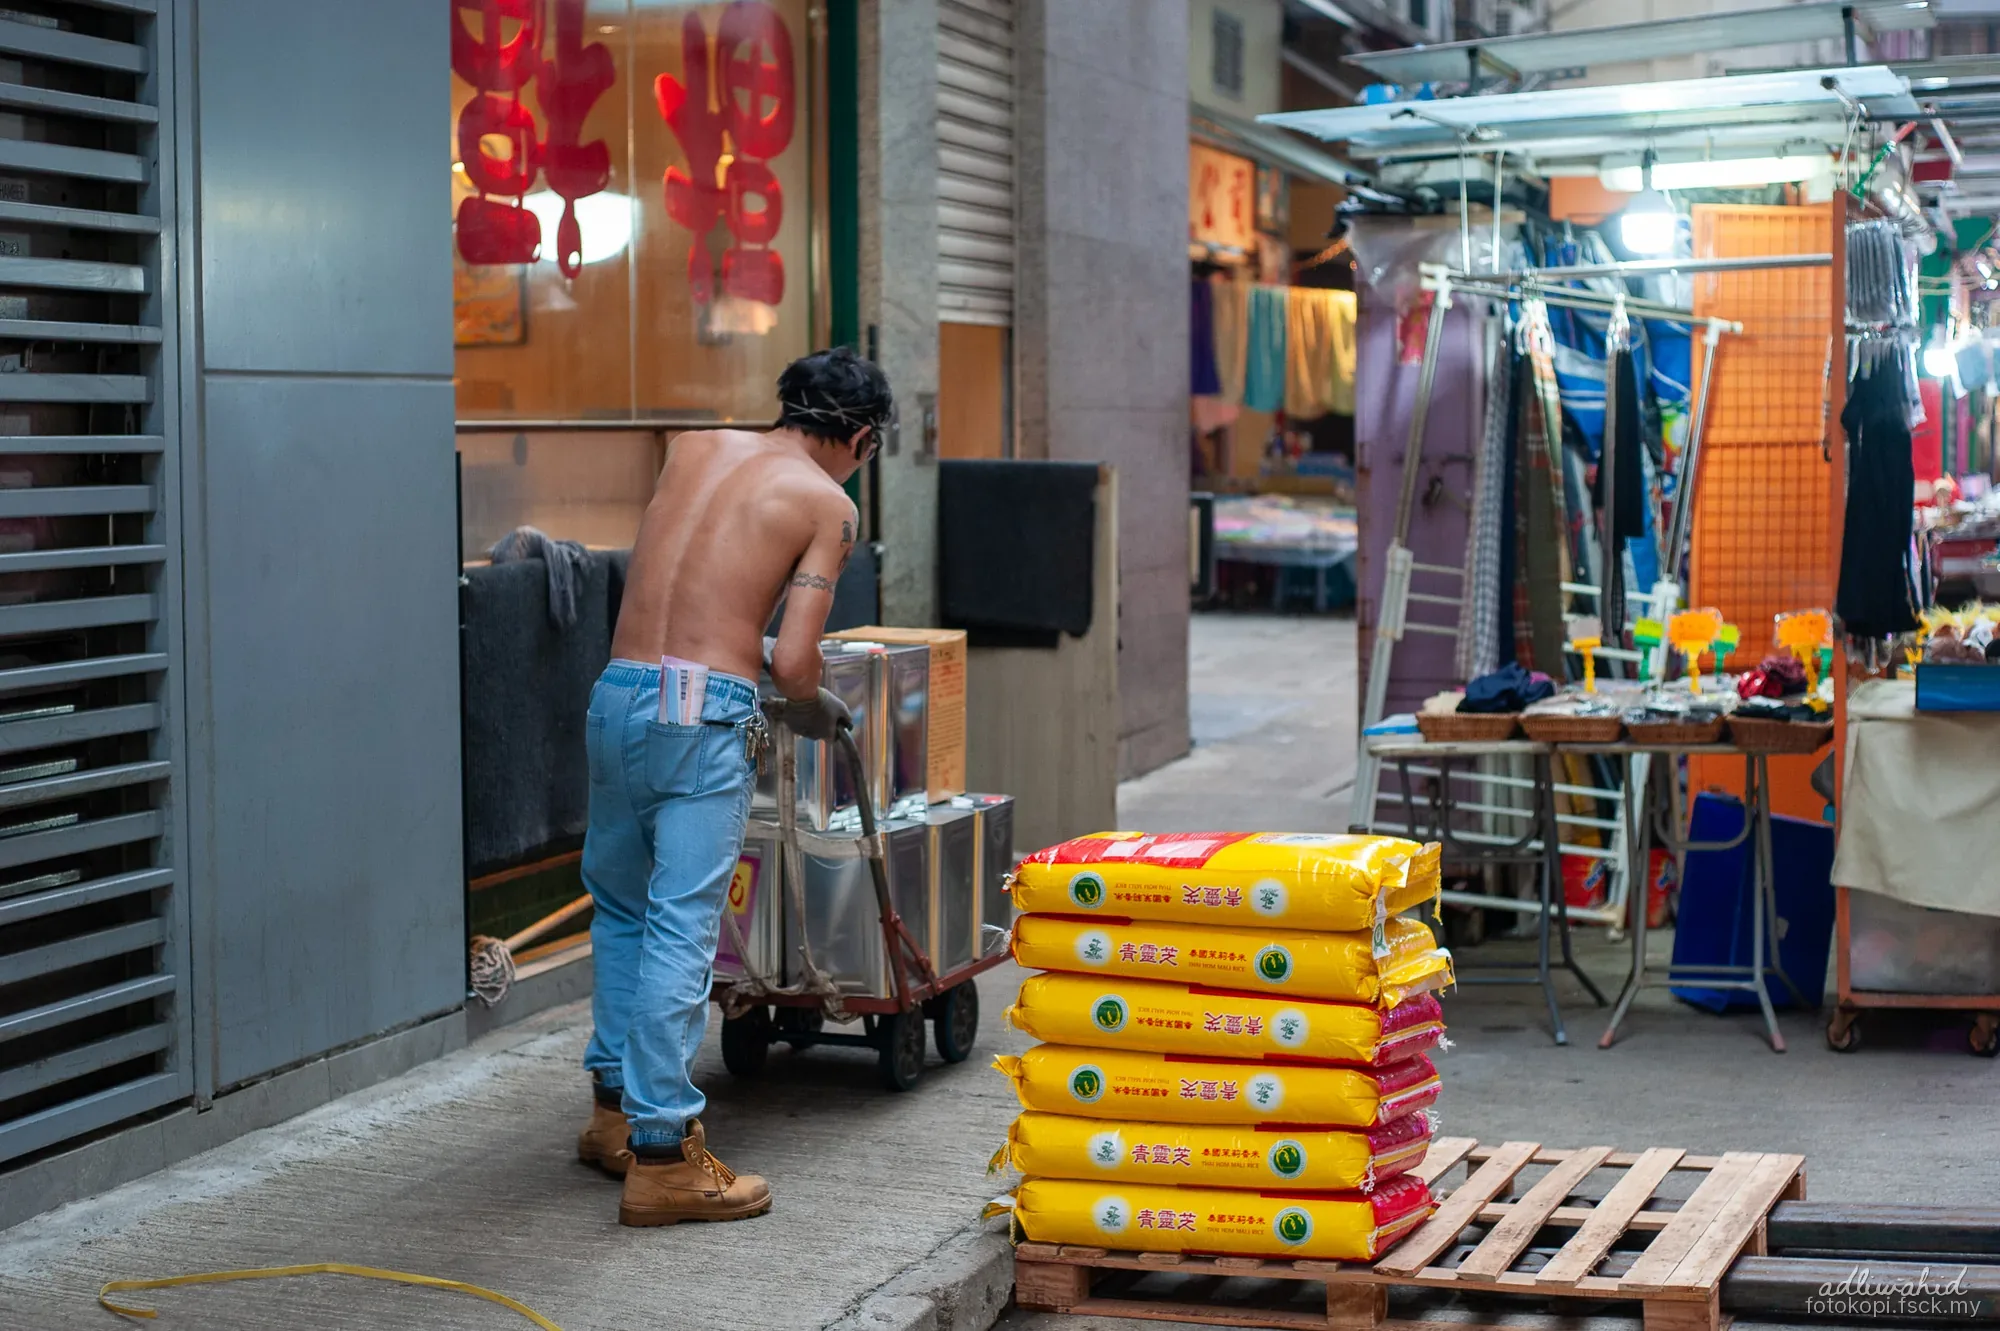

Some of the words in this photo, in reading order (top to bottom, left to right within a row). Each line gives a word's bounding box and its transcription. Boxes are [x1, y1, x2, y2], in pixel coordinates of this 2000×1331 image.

[1181, 885, 1243, 907] 青靈芝
[1119, 943, 1179, 967] 青靈芝
[1203, 1012, 1264, 1036] 青靈芝
[1179, 1078, 1239, 1101] 青靈芝
[1131, 1143, 1192, 1167] 青靈芝
[1136, 1208, 1197, 1233] 青靈芝
